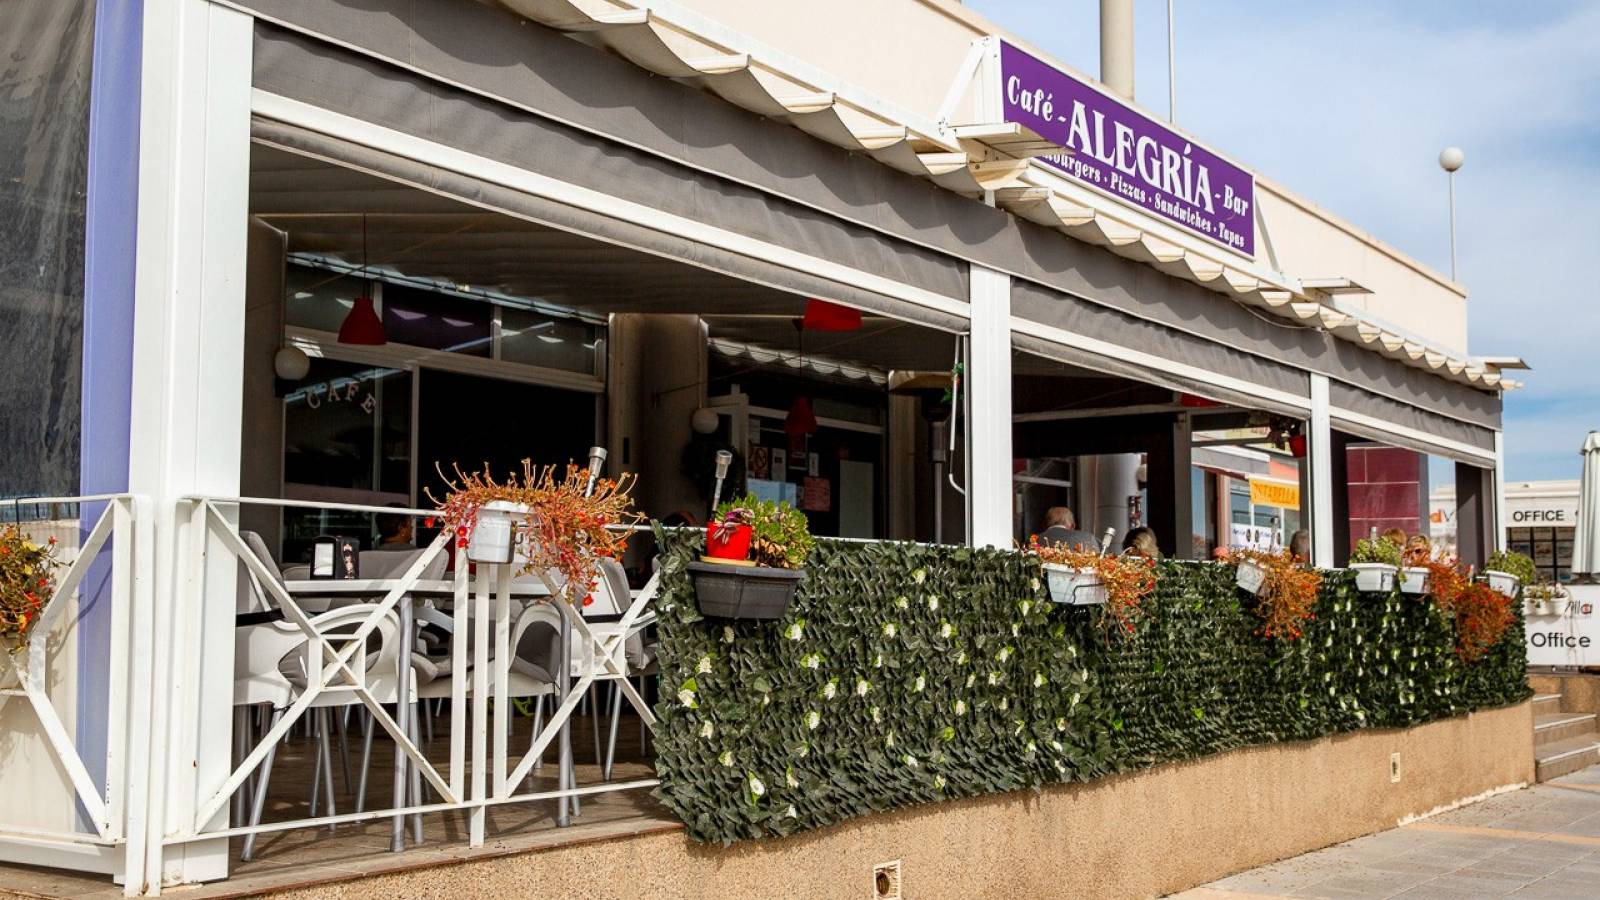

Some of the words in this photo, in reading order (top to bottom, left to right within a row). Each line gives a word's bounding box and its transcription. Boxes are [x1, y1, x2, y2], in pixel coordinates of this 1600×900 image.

[1007, 75, 1053, 122] Café
[1065, 99, 1215, 215] ALEGRÍA
[1222, 183, 1249, 217] Bar
[1110, 171, 1146, 203] Pizzas
[1154, 192, 1212, 233] Sandwiches
[1218, 221, 1245, 248] Tapas
[1513, 509, 1565, 523] OFFICE
[1530, 631, 1591, 649] Office
